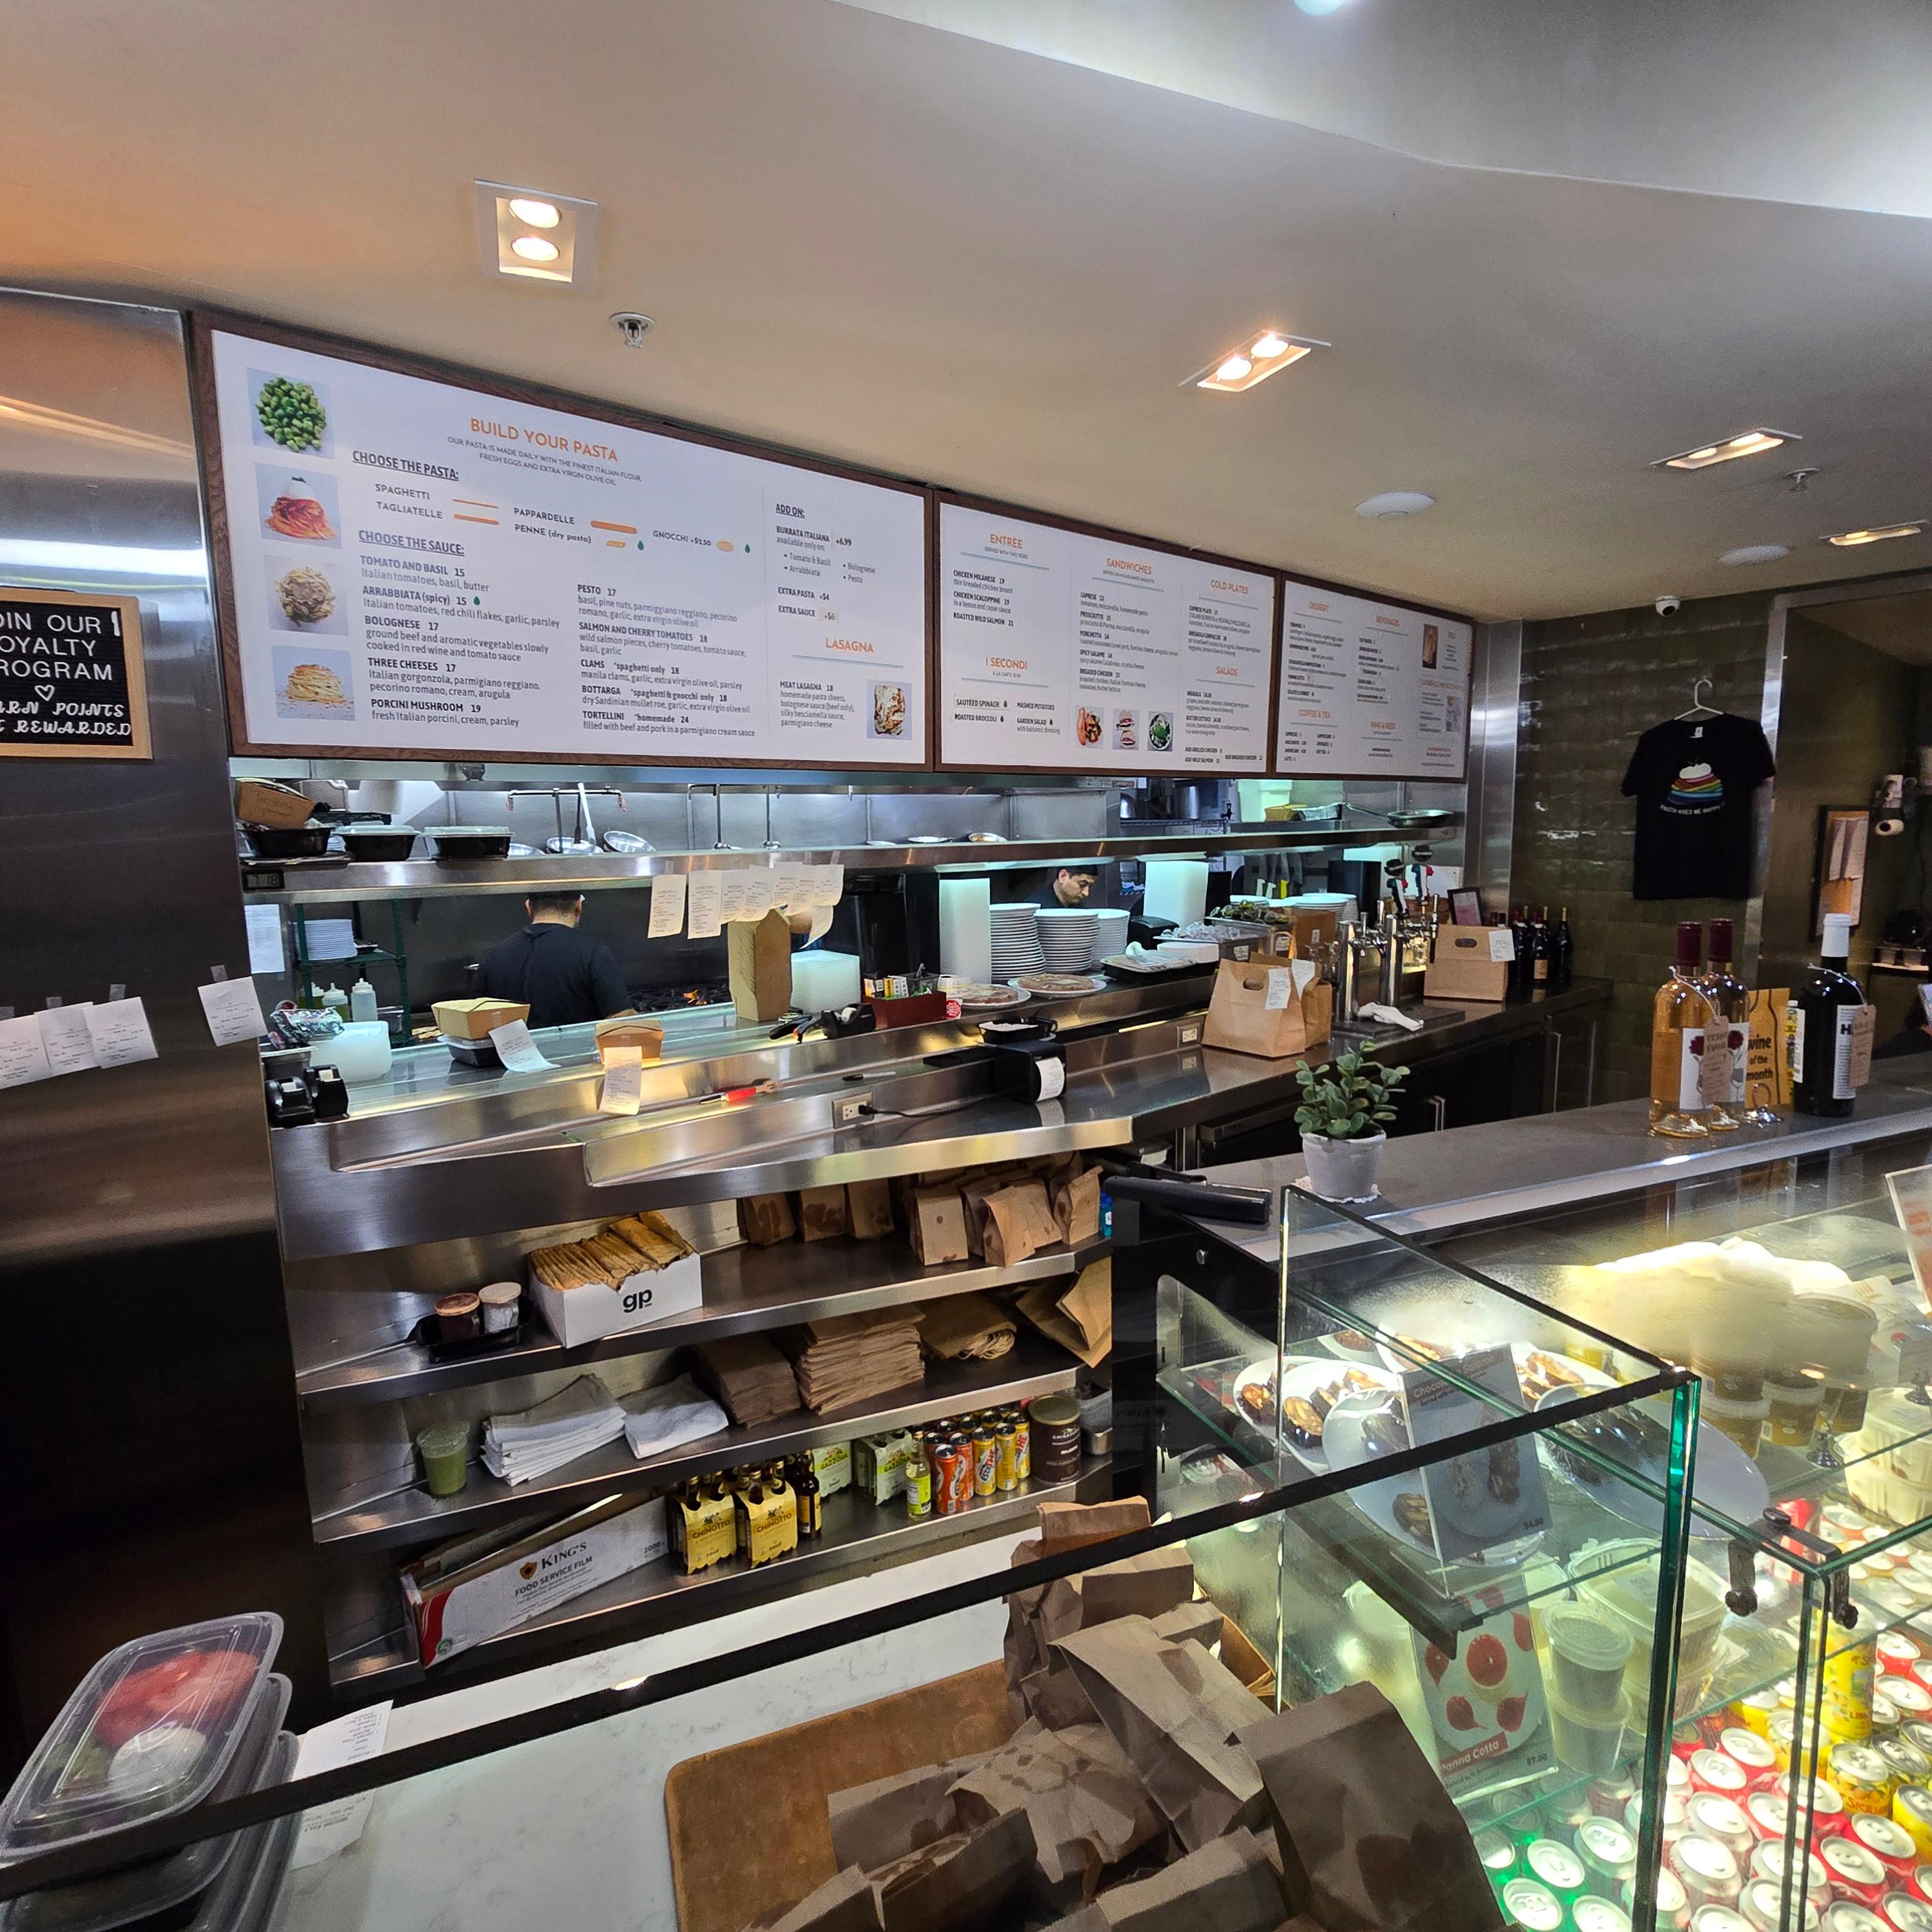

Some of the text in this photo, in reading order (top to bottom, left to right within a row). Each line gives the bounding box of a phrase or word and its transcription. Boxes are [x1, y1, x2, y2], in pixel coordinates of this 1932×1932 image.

[470, 418, 618, 461] BUILD YOUR PASTA
[352, 451, 459, 479] CHOOSE THE PASTA:
[447, 436, 464, 446] OUR
[464, 439, 488, 450] PASTA
[496, 446, 517, 457] MADE
[517, 450, 539, 460] DAILY
[539, 455, 557, 464] WITH
[558, 458, 571, 468] THE
[571, 461, 594, 471] FINEST
[595, 466, 620, 477] ITALIAN
[620, 471, 642, 482] FLOUR
[375, 484, 430, 500] SPAGHETTI
[376, 501, 443, 519] TAGLIATELLE
[513, 508, 575, 524] PAPPARDELLE
[776, 503, 805, 517] ADD ON:
[514, 523, 591, 544] PENNE (dry pasta)
[652, 530, 688, 542] GNOCCHI
[776, 526, 830, 542] BURRATA ITALIANA
[358, 530, 464, 555] CHOOSE THE SAUCE:
[359, 555, 465, 577] TOMATO AND BASIL 15
[789, 565, 821, 577] Arrabbiata
[847, 562, 876, 573] Bolognese
[1106, 557, 1152, 575] SANDWICHES
[577, 584, 616, 596] PESTO 17
[777, 586, 830, 601] EXTRA PASTA +$4
[1210, 579, 1249, 594] COLD PLATES
[362, 586, 467, 606] ARRABBIATA (spicy) 15
[953, 590, 974, 599] CHICKEN
[973, 593, 1000, 604] SCALOPPINE
[777, 605, 816, 617] EXTRA SAUCE
[953, 611, 974, 621] ROASTED
[986, 616, 1005, 625] SALMON
[46, 614, 101, 634] OUR
[364, 615, 439, 631] BOLOGNESE 17
[579, 621, 708, 642] SALMON AND CHERRY TOMATOES 18
[0, 635, 96, 657] OYALTY
[366, 641, 521, 661] cooked in red wine and tomato sauce
[825, 637, 874, 652] LASAGNA
[367, 657, 456, 672] THREE CHEESES 17
[580, 659, 605, 668] CLAMS
[650, 664, 665, 675] only
[990, 657, 1027, 670] SECONDI
[1215, 666, 1238, 676] SALADS
[368, 669, 540, 690] Italian gorgonzola, parmigiano reggiano,
[796, 682, 822, 690] LASAGNA
[581, 684, 621, 695] BOTTARGA
[672, 692, 698, 701] gnocchi
[699, 693, 714, 703] only
[52, 702, 125, 717] POINTS
[370, 698, 481, 713] PORCINI MUSHROOM 19
[956, 698, 978, 706] SAUTÉED
[371, 710, 519, 728] fresh Italian porcini, cream, parsley
[582, 710, 624, 720] TORTELLINI
[13, 719, 131, 736] REWARDED
[622, 1288, 653, 1313] gp
[692, 1519, 730, 1539] CHINOTTO
[756, 1512, 792, 1533] CHINOTTO
[541, 1541, 588, 1570] KING'S
[514, 1556, 593, 1596] FOOD SERVICE FILM
[1472, 1740, 1499, 1759] Cotta
